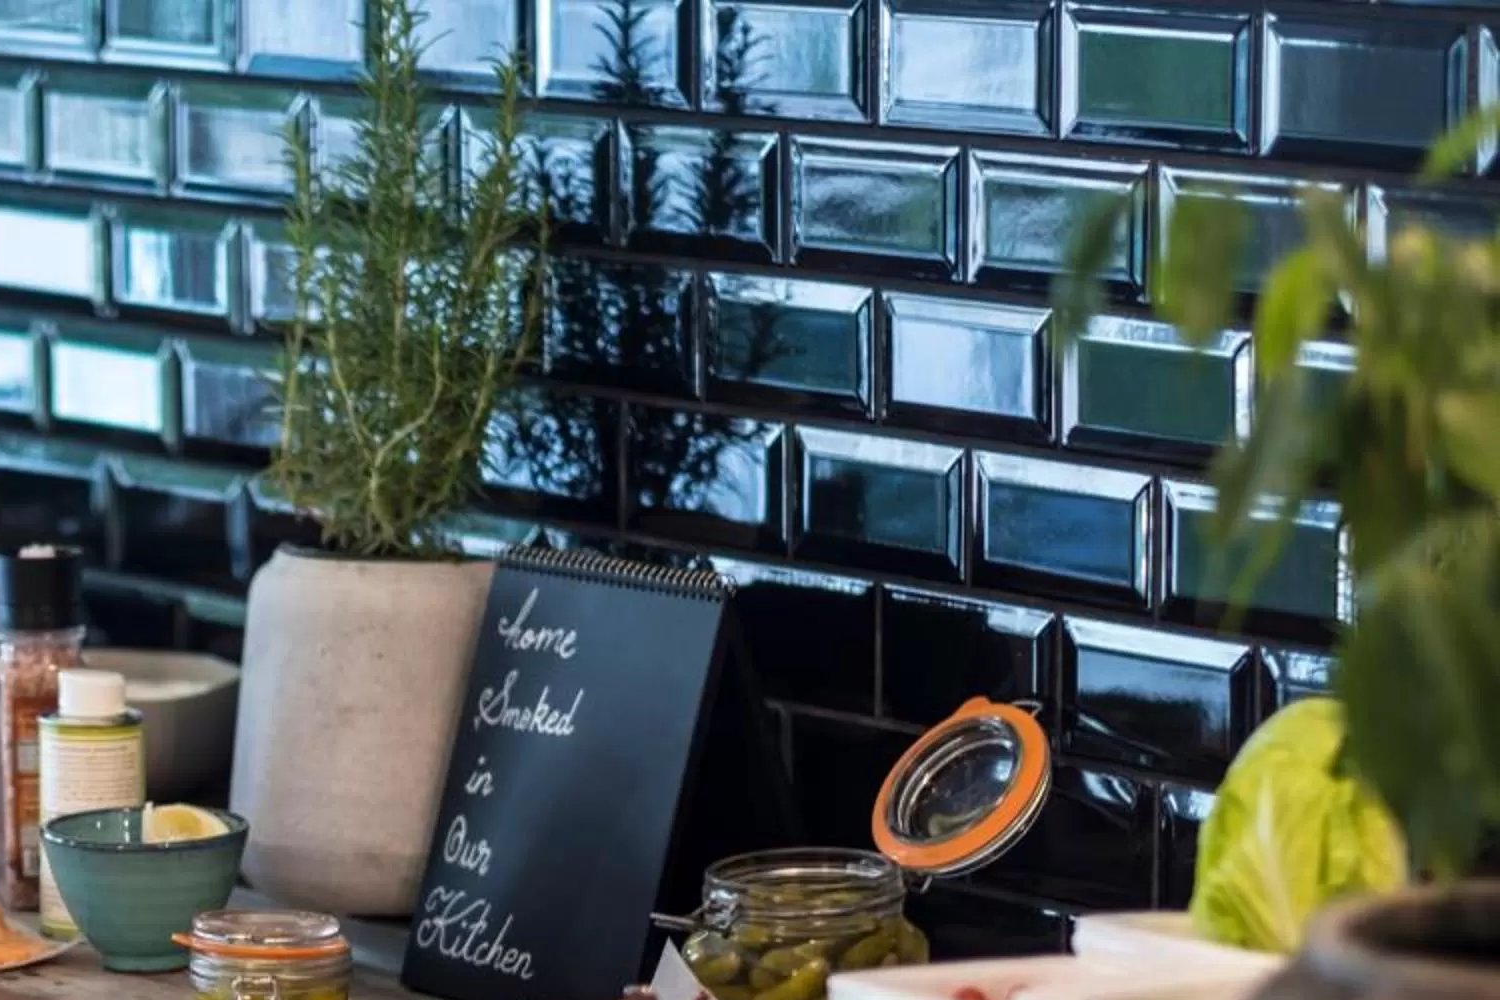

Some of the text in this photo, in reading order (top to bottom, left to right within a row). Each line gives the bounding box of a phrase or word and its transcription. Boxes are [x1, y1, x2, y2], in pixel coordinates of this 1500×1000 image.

[473, 669, 584, 736] Smoked
[464, 755, 494, 796] in
[443, 814, 493, 876] Our
[417, 886, 534, 980] Kitchen
